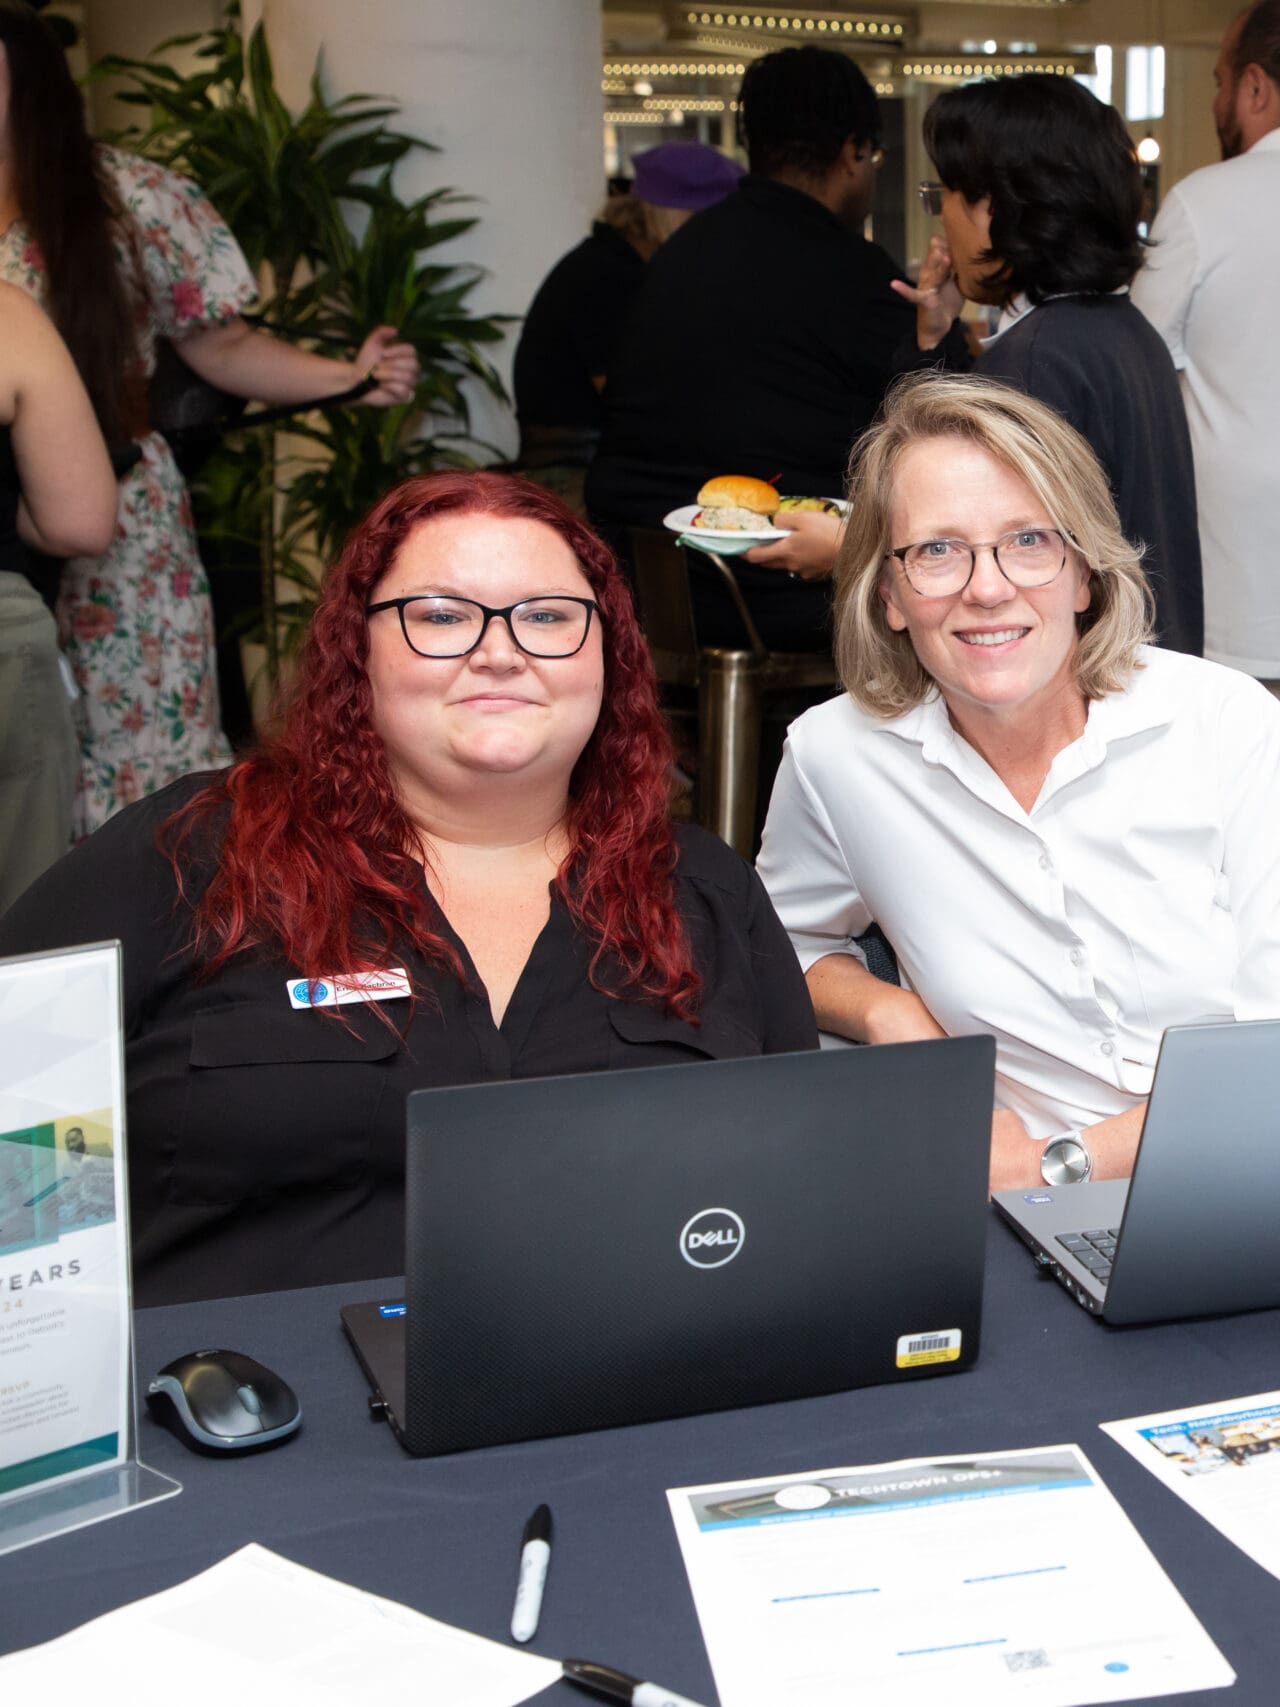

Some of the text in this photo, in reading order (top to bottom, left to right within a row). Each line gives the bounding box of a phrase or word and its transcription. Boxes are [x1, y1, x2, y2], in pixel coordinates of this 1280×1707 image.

[688, 1228, 739, 1249] DELL
[0, 1259, 81, 1291] EARS
[836, 1477, 948, 1498] TECHTOWN
